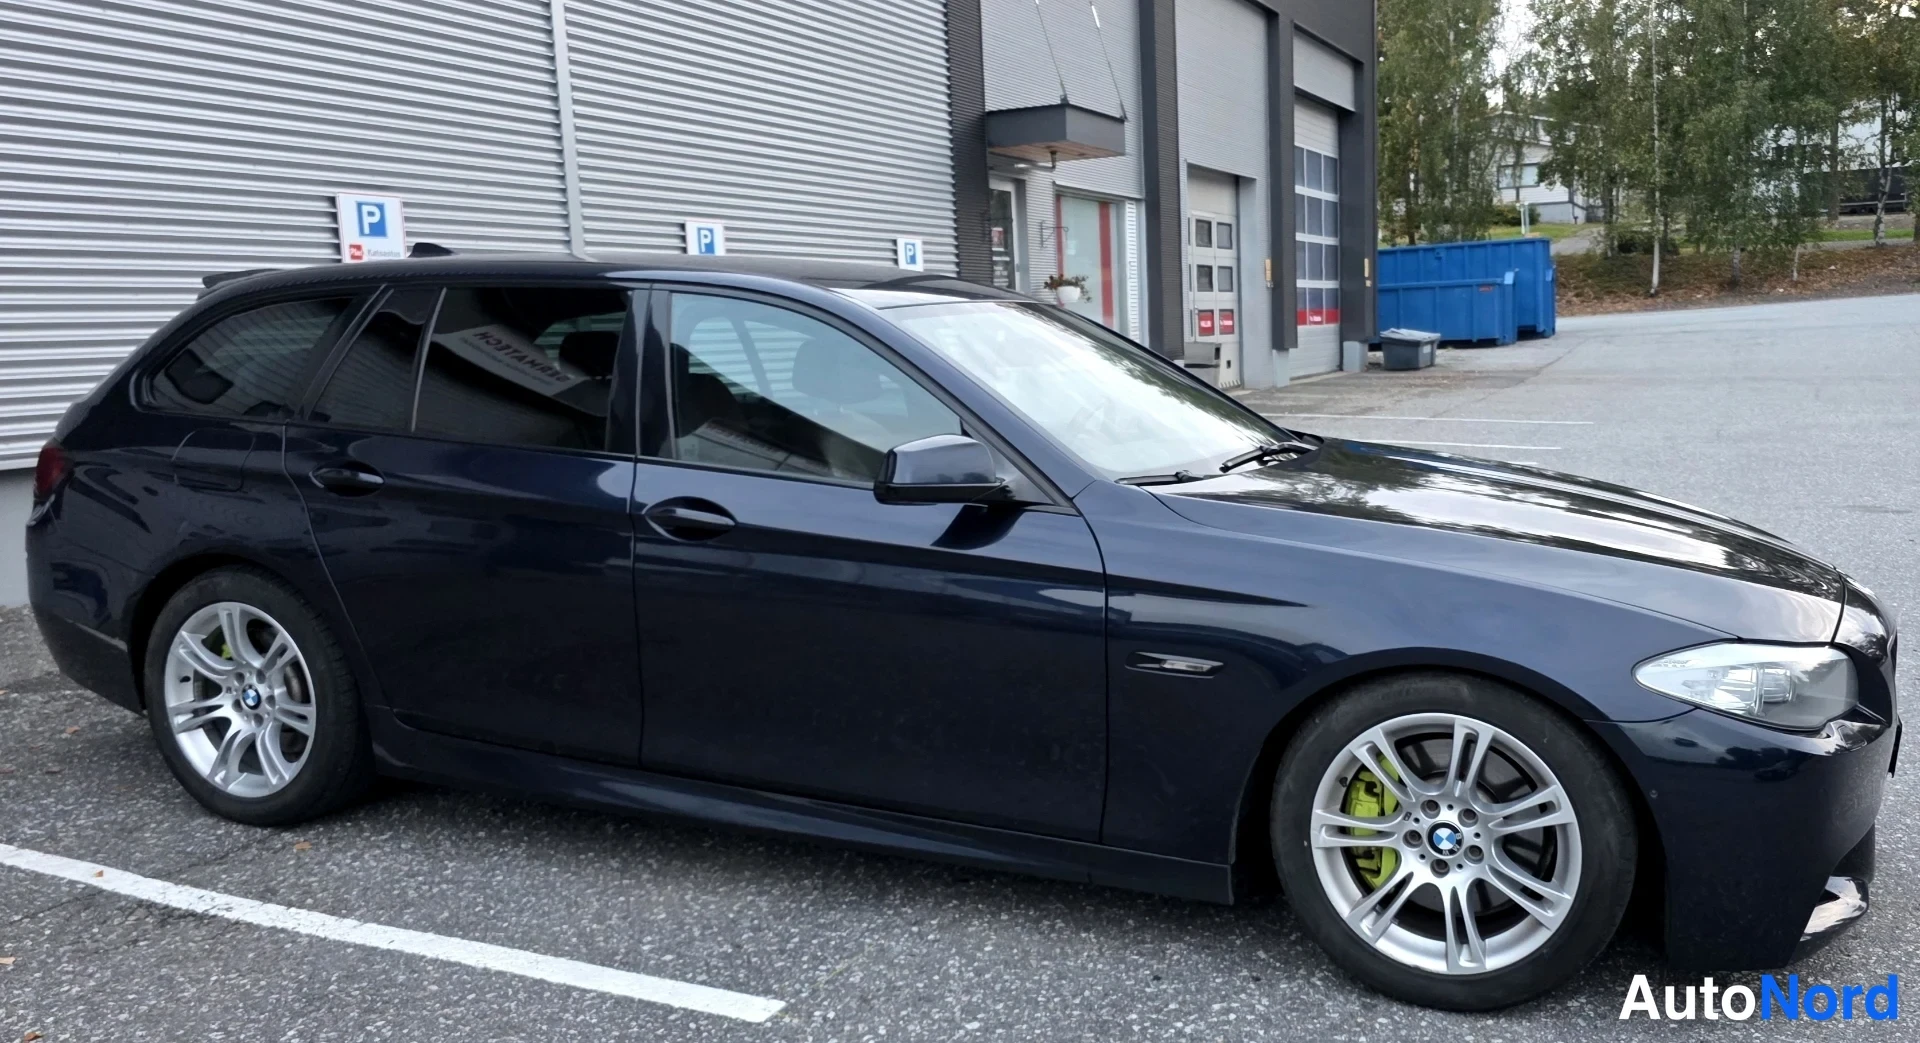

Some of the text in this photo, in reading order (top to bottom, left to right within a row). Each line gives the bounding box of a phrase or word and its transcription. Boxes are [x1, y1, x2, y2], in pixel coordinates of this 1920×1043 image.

[361, 205, 381, 235] P
[700, 229, 711, 252] P
[906, 244, 914, 263] P
